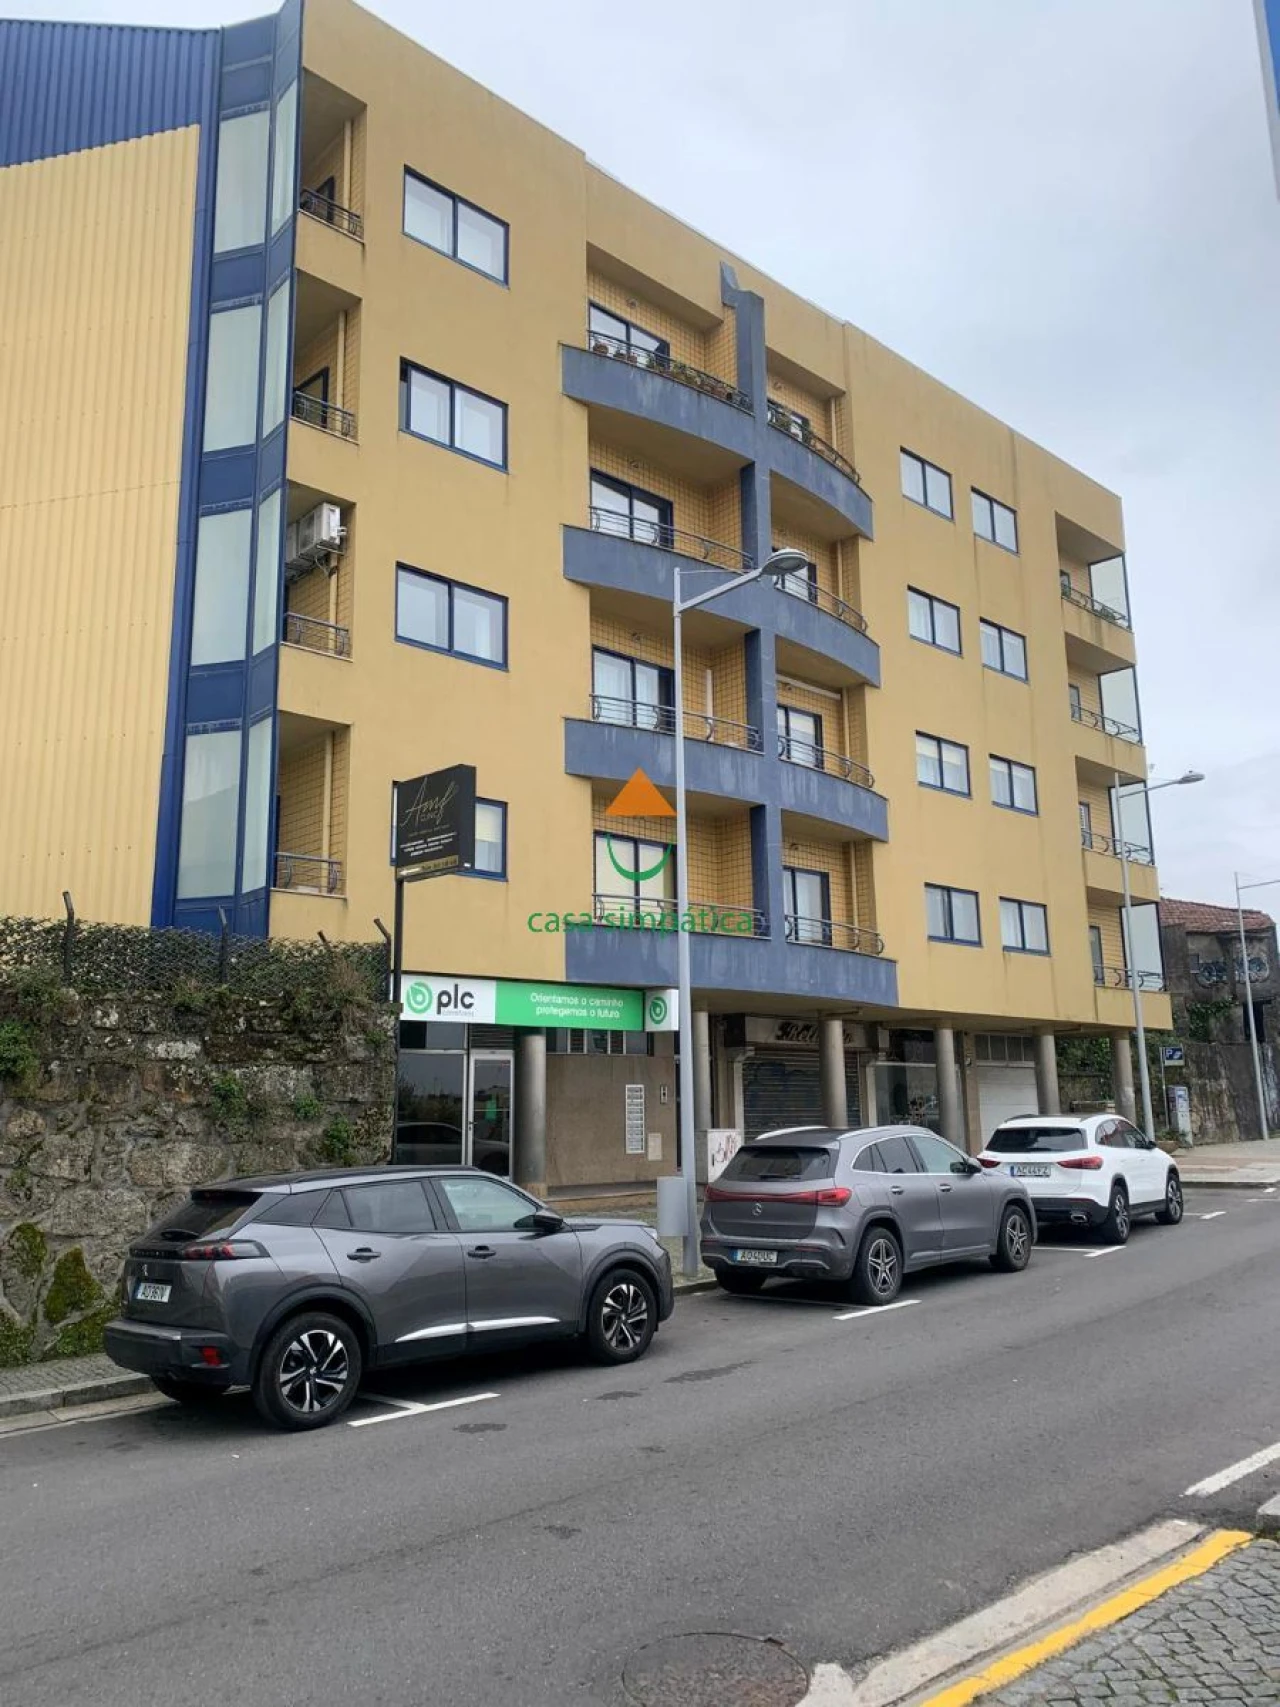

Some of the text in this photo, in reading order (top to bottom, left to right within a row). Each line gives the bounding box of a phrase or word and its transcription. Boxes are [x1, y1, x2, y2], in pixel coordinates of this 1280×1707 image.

[436, 983, 475, 1015] plc
[530, 992, 579, 1005] Orientamos
[589, 998, 623, 1008] caminho
[536, 1006, 587, 1017] protegemos
[597, 1009, 620, 1018] futuro
